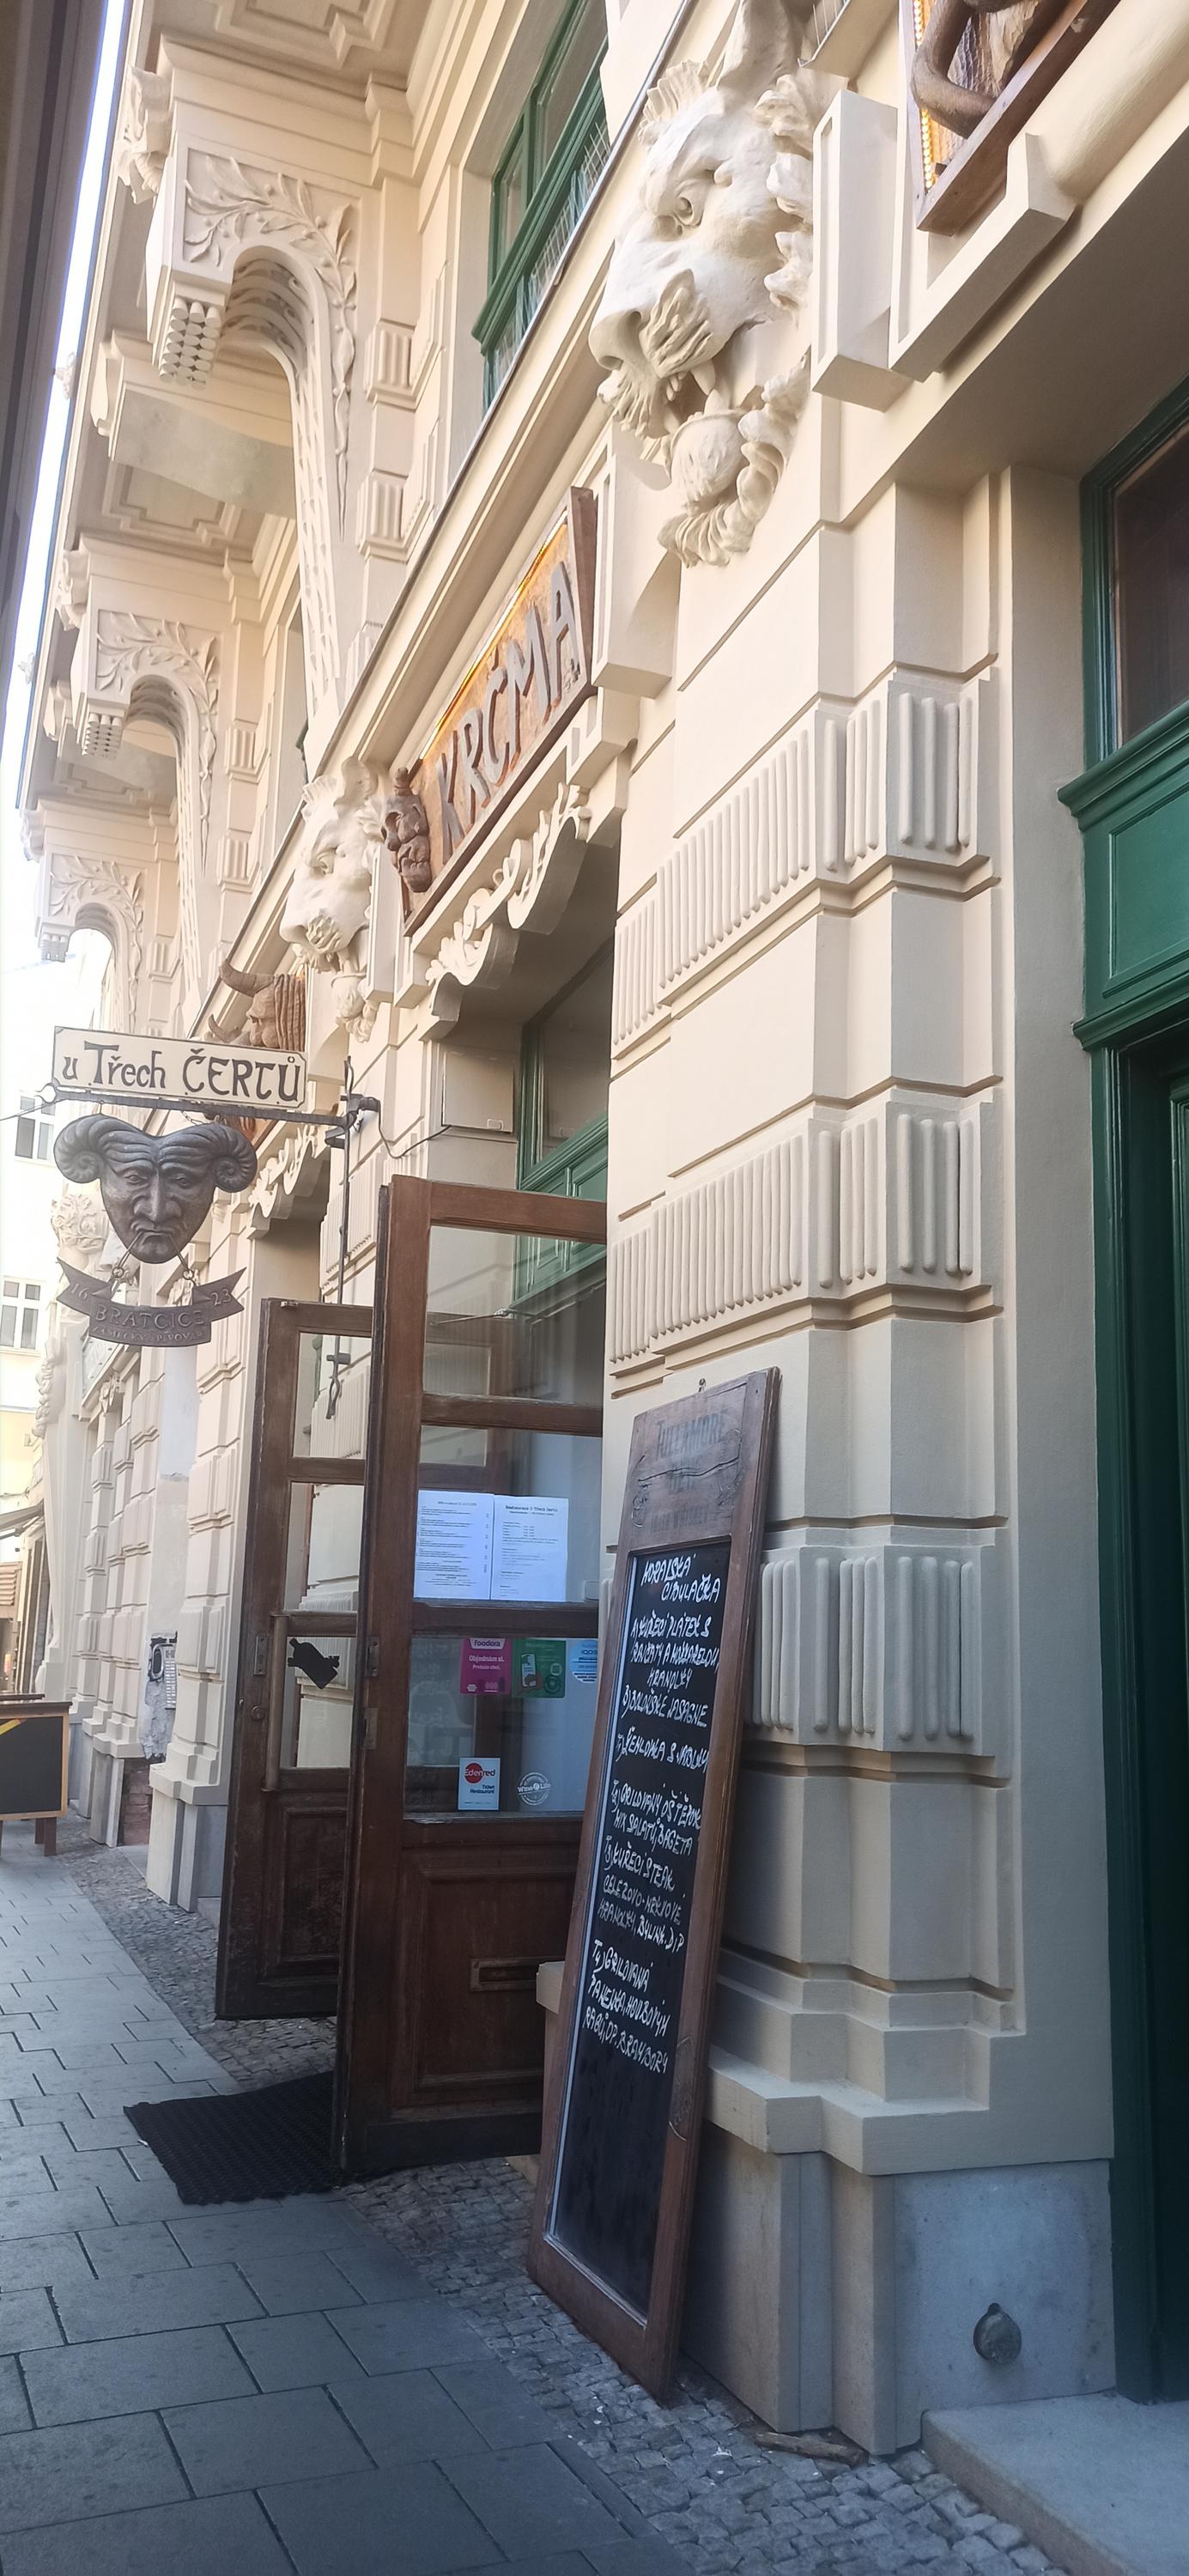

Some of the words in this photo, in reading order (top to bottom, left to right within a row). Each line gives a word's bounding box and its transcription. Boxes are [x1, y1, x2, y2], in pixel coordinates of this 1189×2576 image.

[435, 560, 581, 865] KRČMA
[63, 1056, 78, 1080] u
[84, 1041, 166, 1089] Třech
[182, 1048, 300, 1102] ČERTŮ
[70, 1284, 88, 1299] 16
[212, 1289, 232, 1306] 23
[640, 1553, 696, 1586] HORALSKÁ
[661, 1573, 721, 1603] CIBULAČKA
[701, 1616, 712, 1637] S
[657, 1823, 693, 1856] BAGETA
[643, 1857, 675, 1892] STEAK
[665, 1927, 684, 1953] DIP
